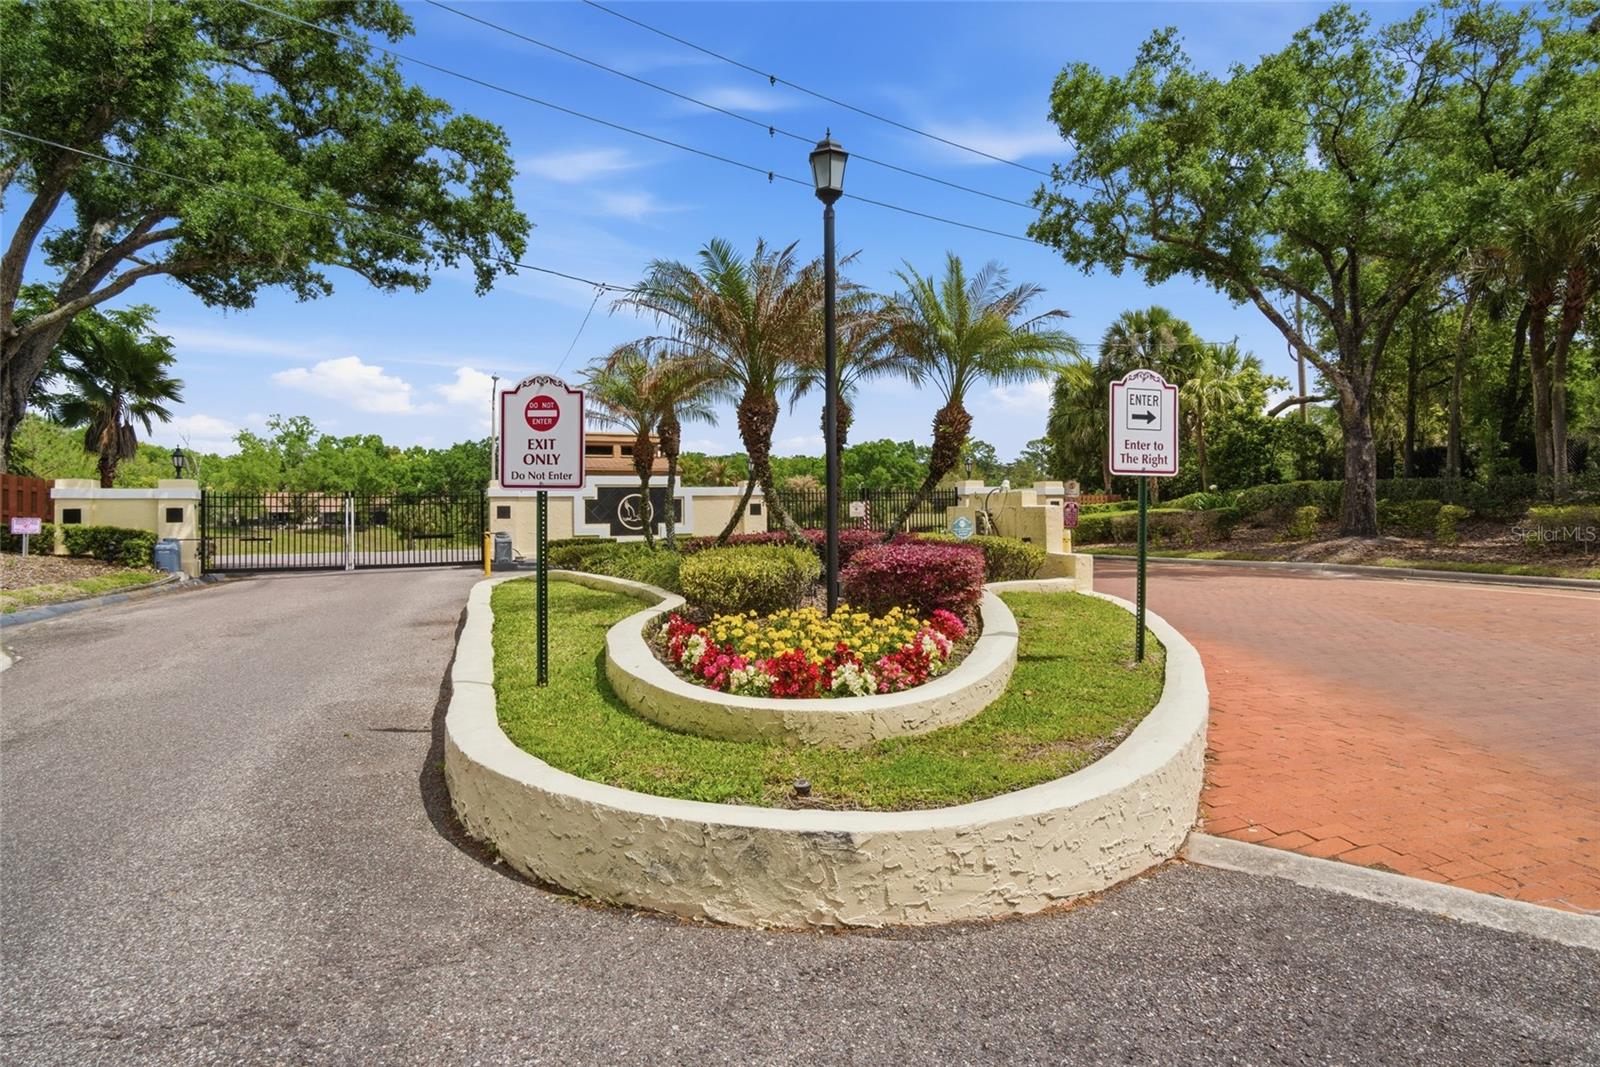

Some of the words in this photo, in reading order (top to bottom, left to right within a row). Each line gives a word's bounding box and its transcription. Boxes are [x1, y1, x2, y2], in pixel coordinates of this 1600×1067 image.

[1130, 394, 1158, 406] ENTER
[528, 439, 556, 450] EXIT
[1124, 440, 1150, 450] Enter
[1154, 441, 1164, 450] to
[523, 454, 560, 465] ONLY
[1120, 453, 1138, 464] The
[1142, 454, 1168, 468] Right
[511, 471, 525, 480] Do
[528, 471, 545, 480] Not
[548, 471, 572, 480] Enter
